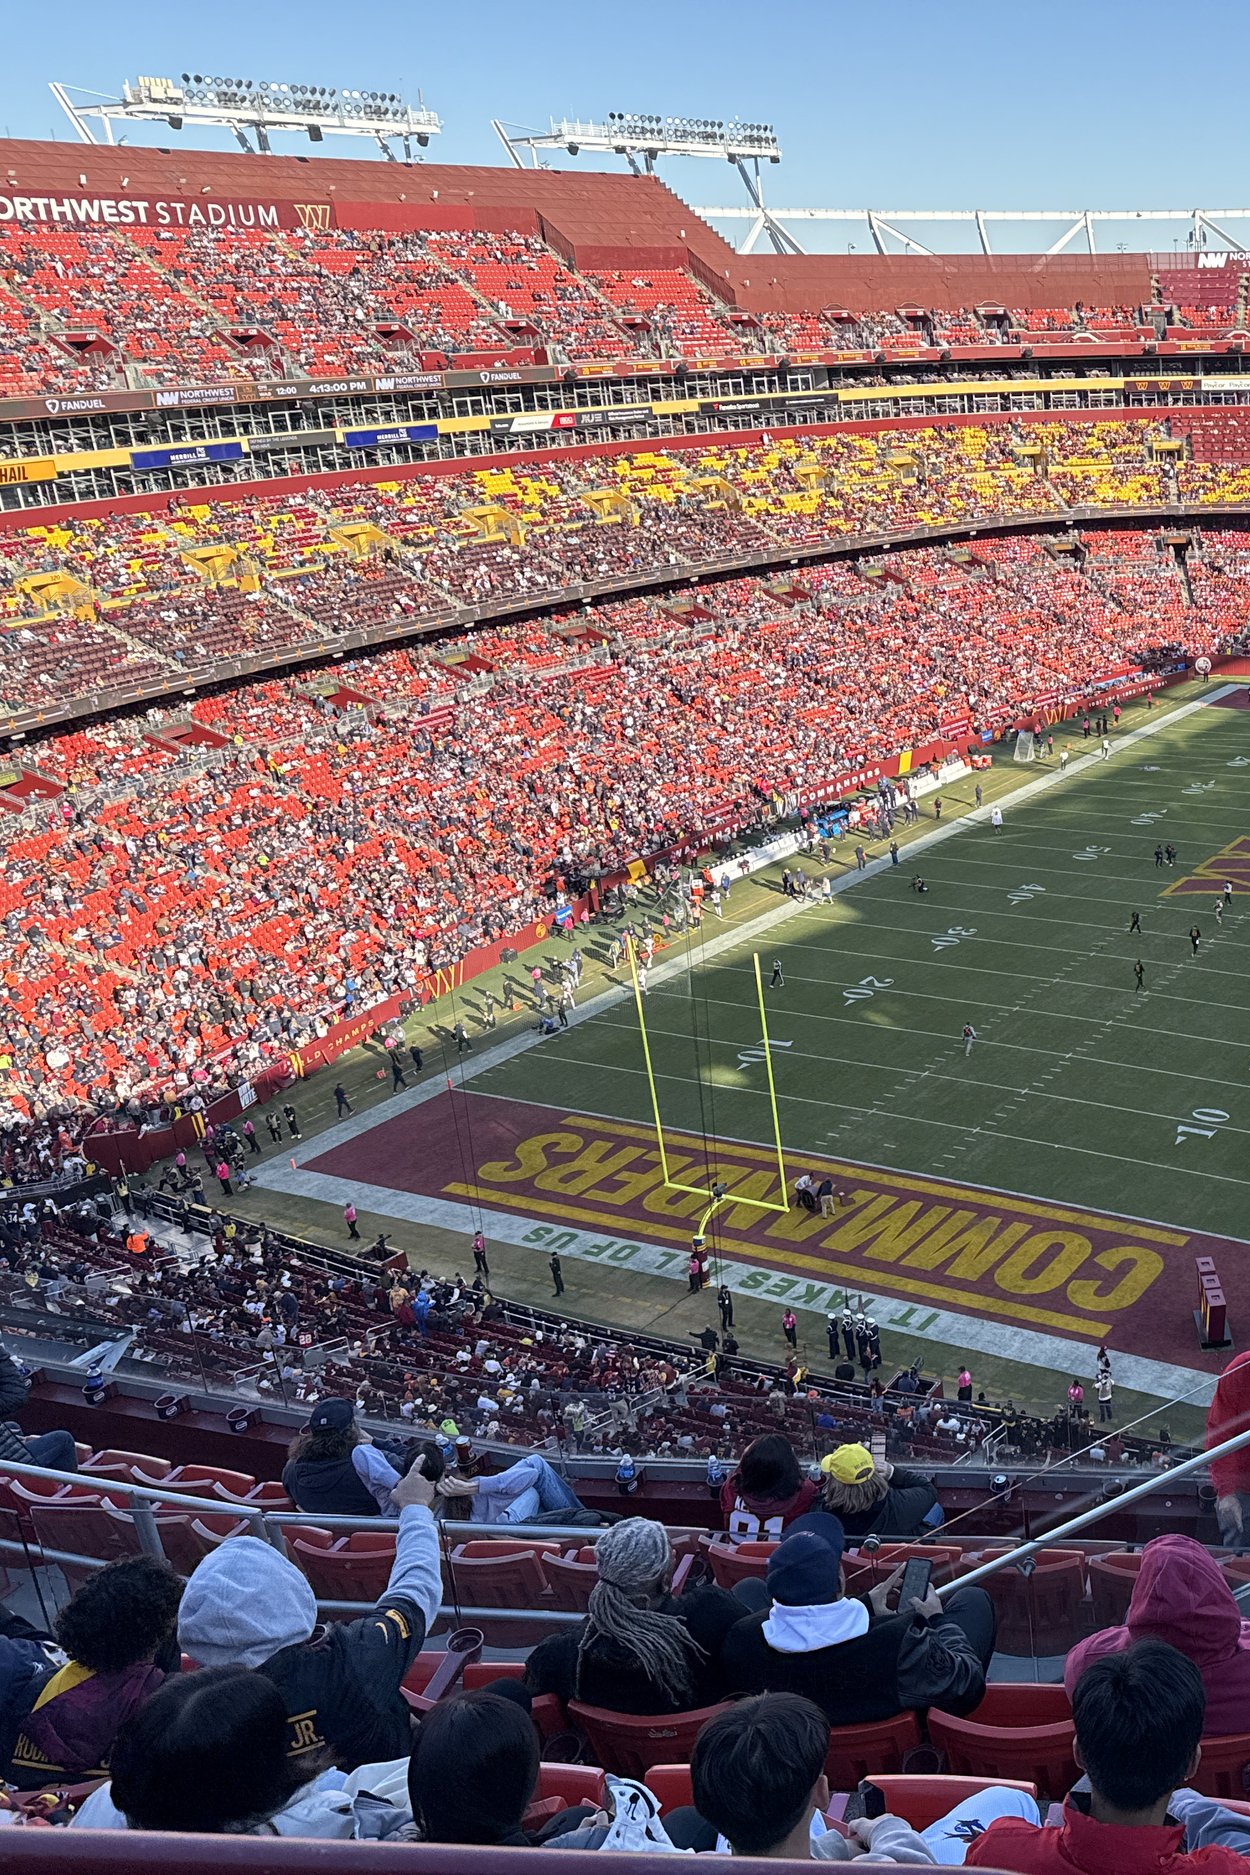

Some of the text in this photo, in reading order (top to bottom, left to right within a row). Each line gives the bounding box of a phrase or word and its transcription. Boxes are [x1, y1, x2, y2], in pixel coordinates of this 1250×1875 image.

[0, 196, 279, 226] ORTHWEST STADIUM
[1198, 252, 1228, 268] NW
[375, 378, 395, 391] NW
[395, 374, 442, 384] NORTHWEST
[491, 372, 522, 383] FANDUEL
[180, 388, 235, 399] NORTHWEST
[276, 386, 297, 395] 12:00
[309, 382, 367, 393] 4:13:00 PM
[61, 399, 106, 411] FANDUEL
[156, 391, 179, 406] NW
[0, 465, 29, 483] HAIL
[800, 767, 881, 804] COMMANDERS
[1072, 845, 1112, 860] 50
[1007, 883, 1046, 900] 40
[931, 926, 978, 946] 30
[843, 975, 895, 999] 20
[328, 1019, 375, 1050] CHAMPS
[737, 1039, 794, 1062] 10
[1177, 1108, 1230, 1139] 10
[8, 1214, 17, 1223] 34
[477, 1132, 1163, 1310] COMMANDERS
[521, 1226, 940, 1332] IT TAKES AL OF US
[299, 1334, 312, 1345] 28
[729, 1510, 784, 1545] 91
[291, 1720, 324, 1748] JR.
